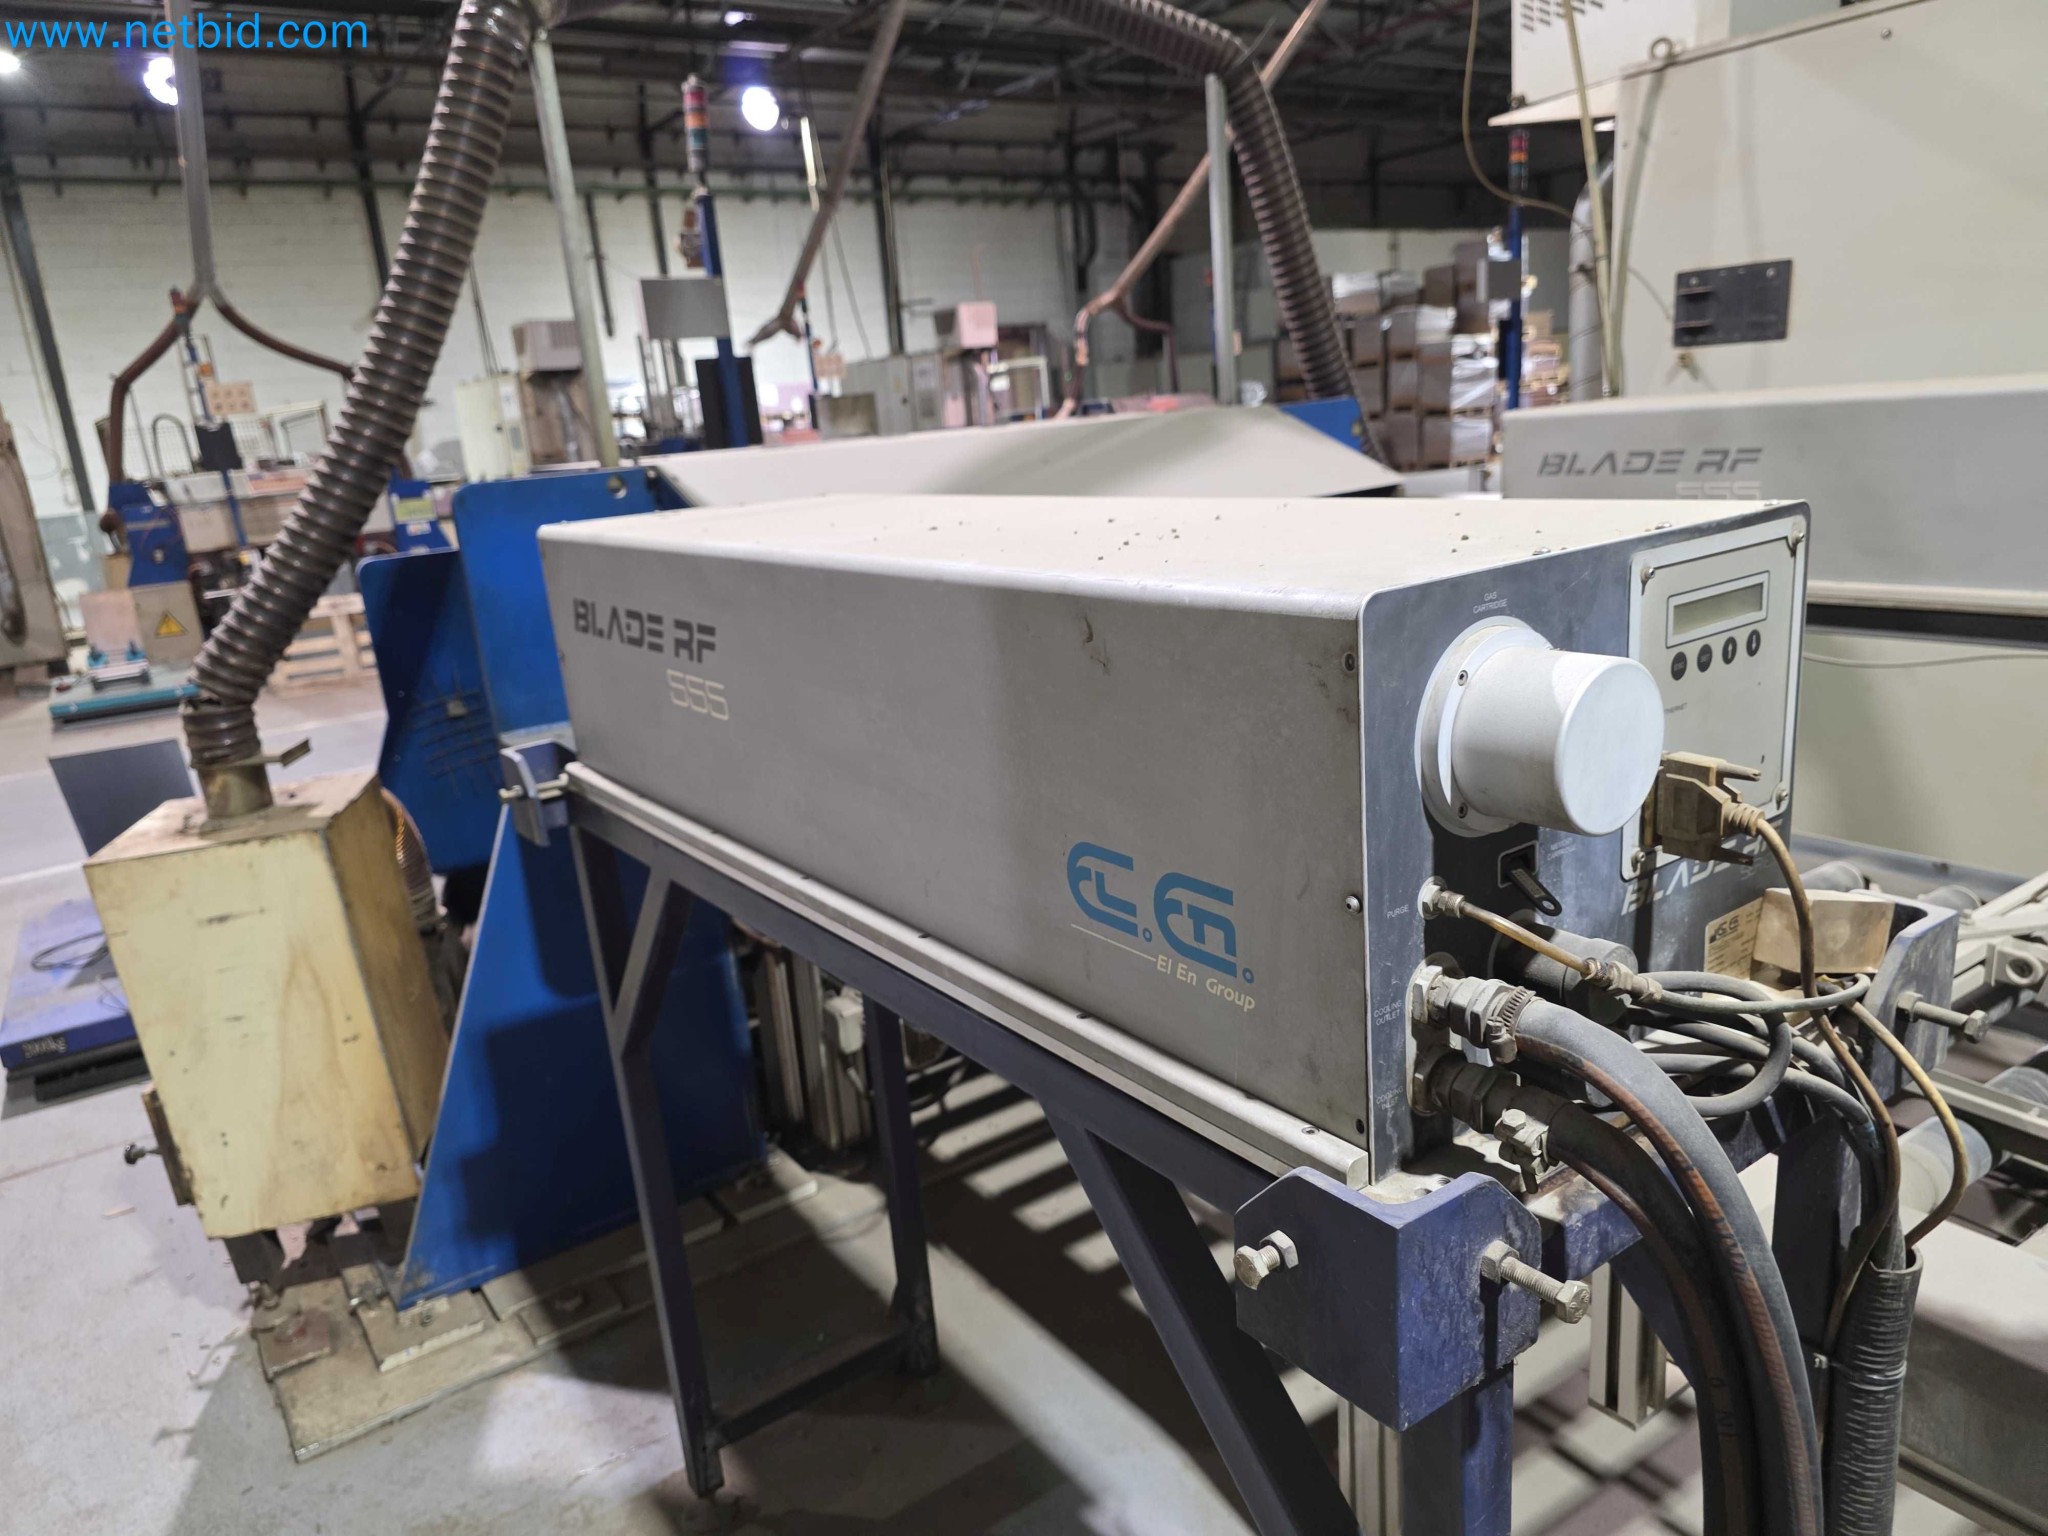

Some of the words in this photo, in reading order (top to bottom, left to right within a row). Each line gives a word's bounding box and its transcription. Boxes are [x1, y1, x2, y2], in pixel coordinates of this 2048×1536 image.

[1537, 450, 1685, 477] BLADE
[1694, 447, 1763, 474] RF
[1483, 591, 1498, 602] GAS
[1472, 598, 1508, 614] CARTRIDGE
[573, 597, 664, 654] BLADE
[673, 618, 717, 664] RF
[1386, 904, 1409, 919] PURGE
[1176, 962, 1197, 986] En
[1206, 977, 1256, 1012] Group
[1373, 1000, 1403, 1018] COOLING
[1375, 1009, 1401, 1026] OUTLET
[1376, 1086, 1404, 1105] COOLING
